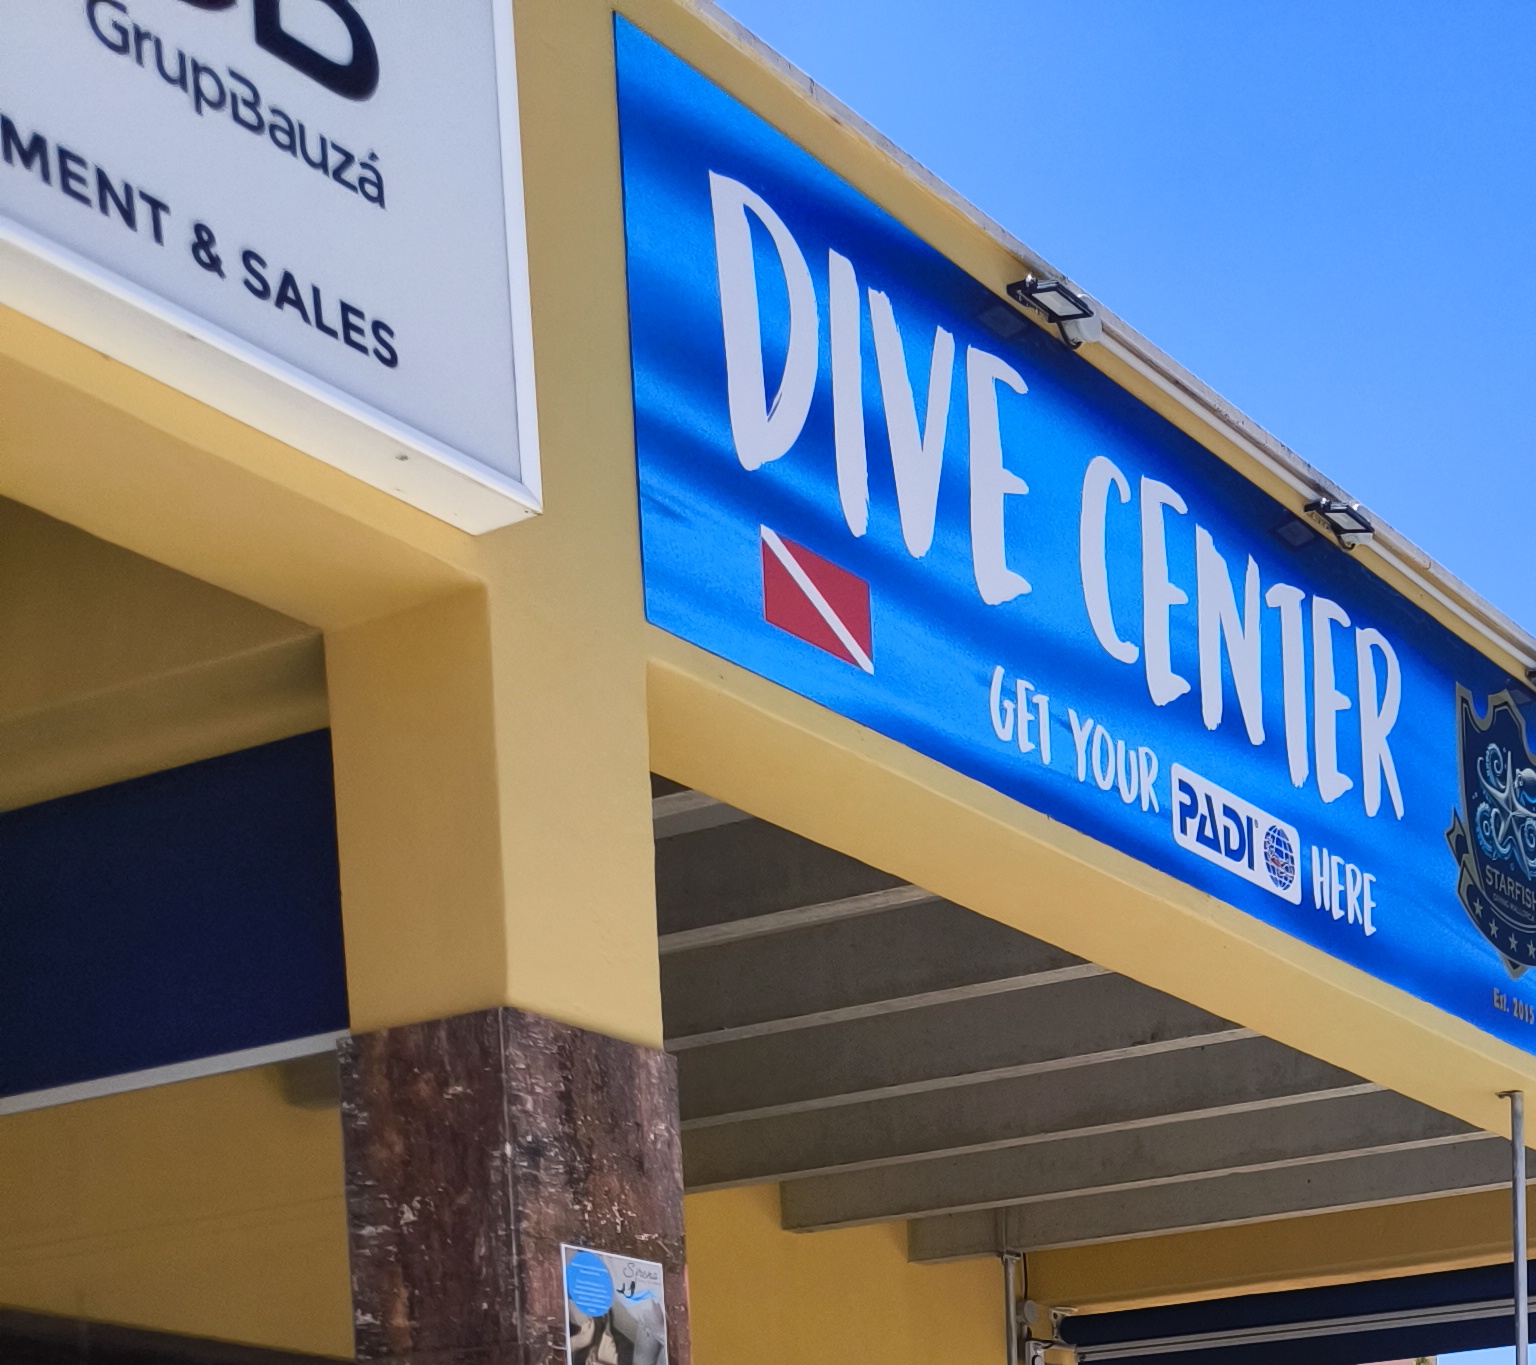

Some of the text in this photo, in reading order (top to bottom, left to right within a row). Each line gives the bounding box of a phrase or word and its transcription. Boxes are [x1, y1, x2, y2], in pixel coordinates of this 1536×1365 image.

[86, 0, 387, 209] GrupBauzá
[191, 223, 225, 279] &
[241, 250, 399, 368] SALES
[708, 169, 1404, 820] DIVE CENTER
[989, 665, 1050, 766] GET
[1067, 708, 1160, 813] YOUR
[1311, 845, 1377, 936] HERE
[1493, 986, 1535, 1025] Est. 2015
